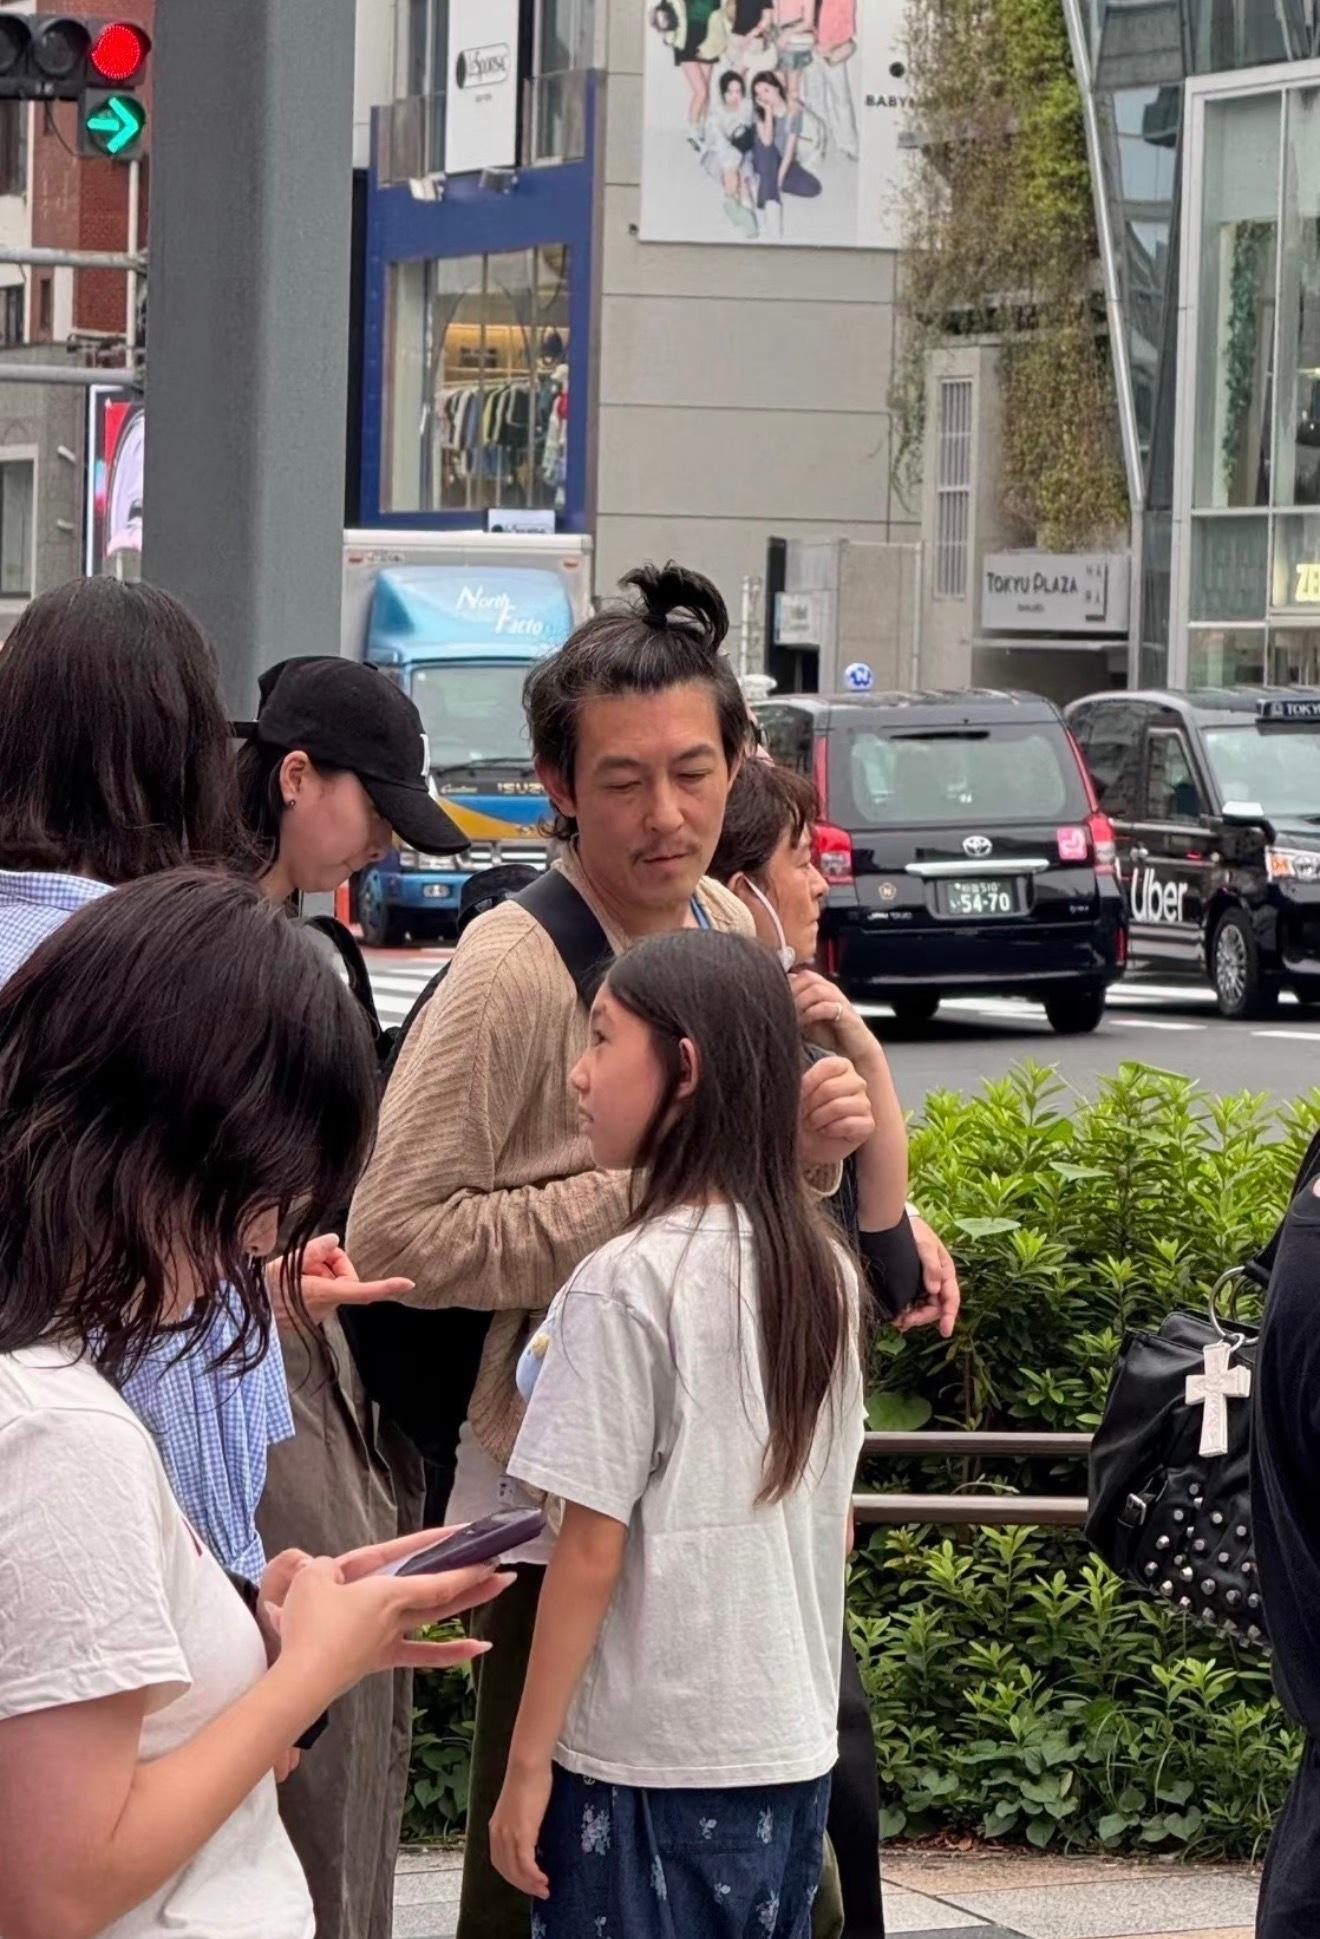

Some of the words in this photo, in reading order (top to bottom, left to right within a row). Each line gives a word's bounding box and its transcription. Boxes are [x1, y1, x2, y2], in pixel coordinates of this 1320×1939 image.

[865, 94, 914, 108] BABY
[986, 572, 1031, 594] TOKYU
[1032, 571, 1078, 594] PLAZA
[1286, 703, 1320, 717] TOKY
[1130, 866, 1189, 923] Uber
